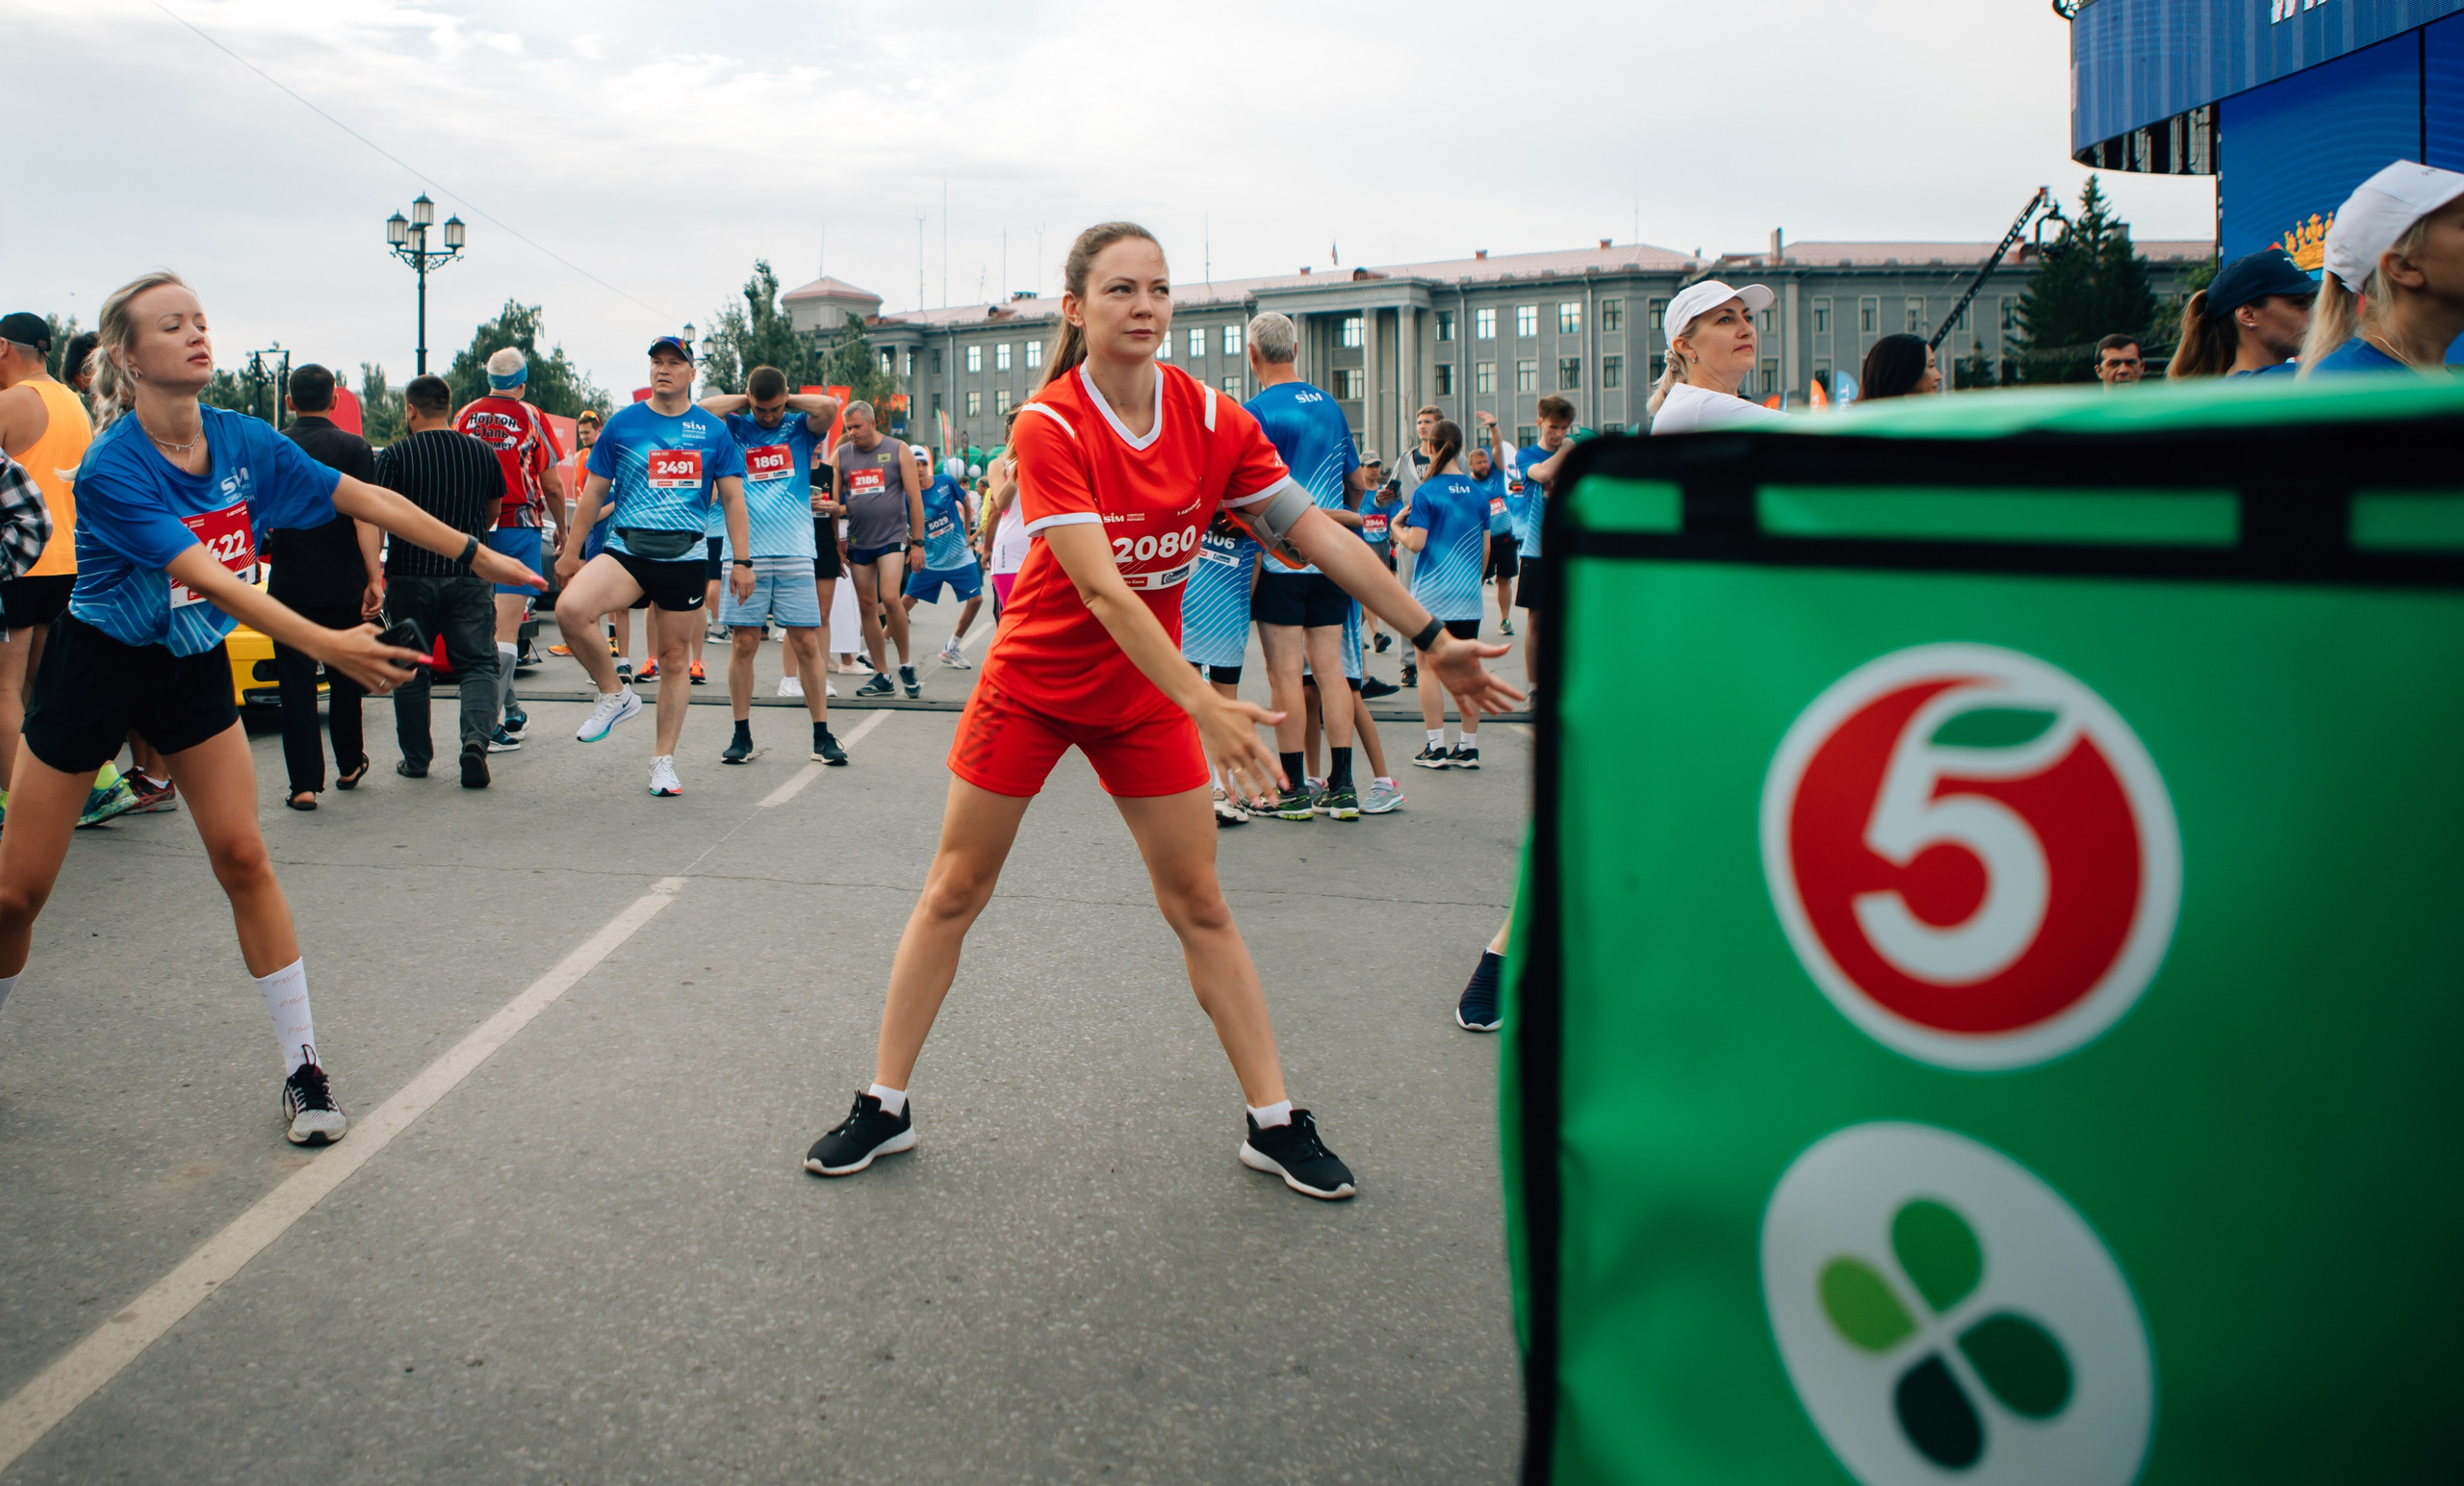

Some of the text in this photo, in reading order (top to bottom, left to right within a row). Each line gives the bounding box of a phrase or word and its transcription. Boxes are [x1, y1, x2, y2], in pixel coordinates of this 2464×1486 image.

[469, 412, 517, 428] Нортон
[473, 424, 508, 439] Сталь
[656, 460, 694, 474] 2491
[754, 453, 784, 469] 1861
[855, 474, 880, 486] 2186
[929, 516, 949, 530] 5029
[1113, 525, 1196, 563] 2080
[1851, 681, 2085, 988] 5
